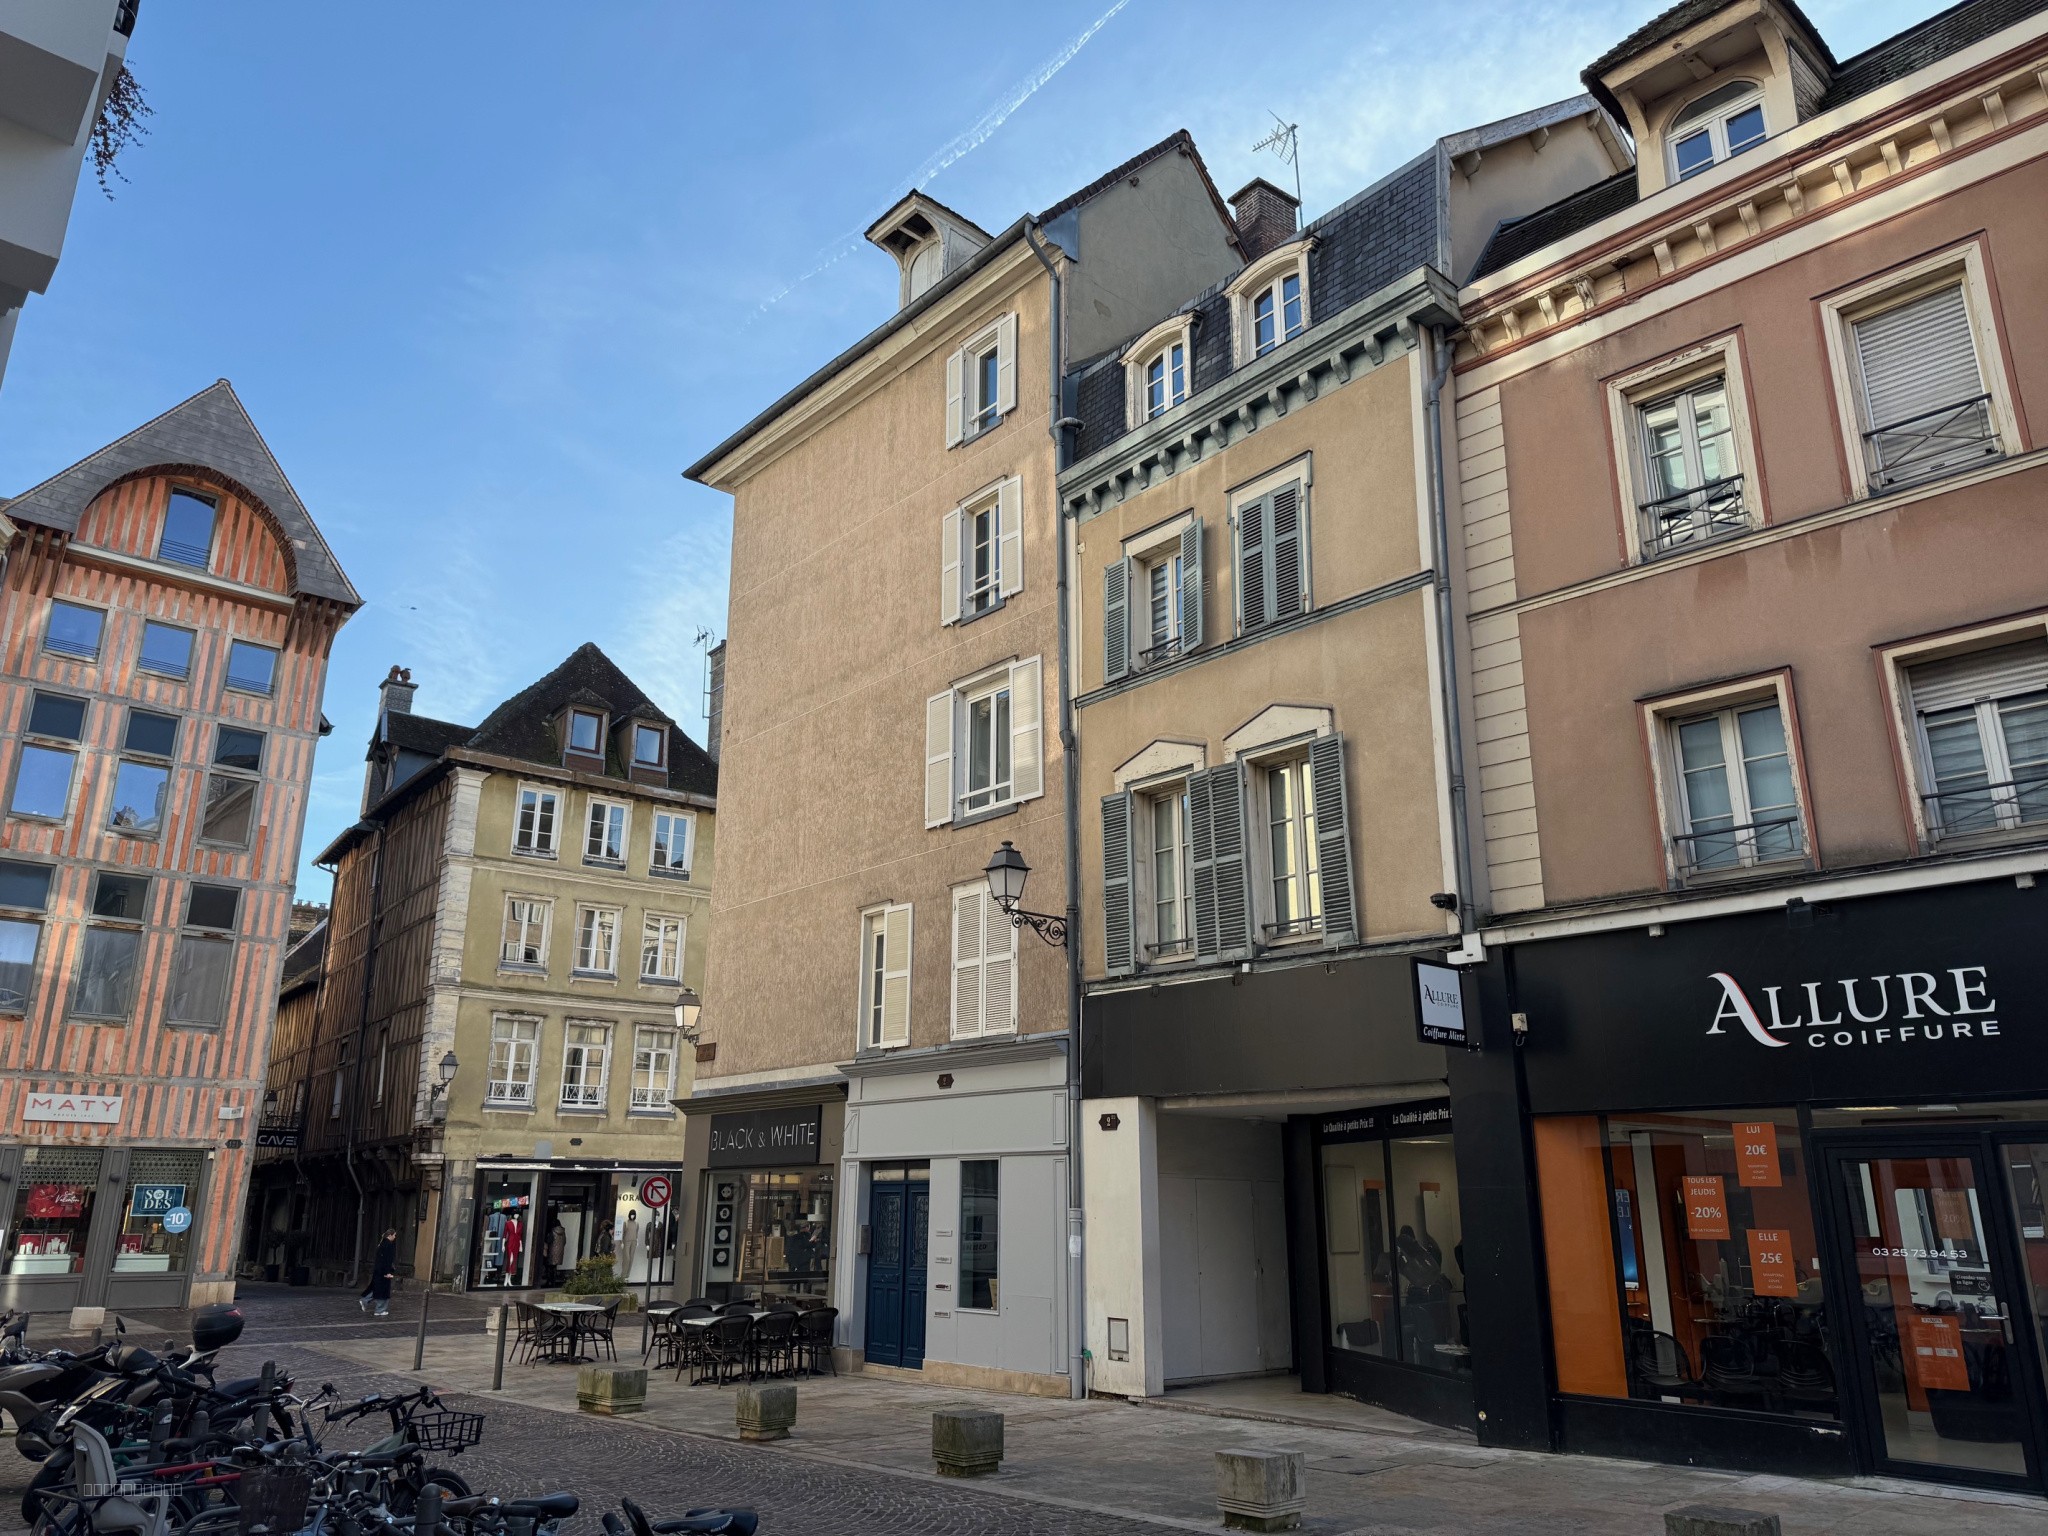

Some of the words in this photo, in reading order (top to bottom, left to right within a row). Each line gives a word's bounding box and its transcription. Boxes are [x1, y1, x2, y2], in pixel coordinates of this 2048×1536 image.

[1423, 1026, 1447, 1040] Coiffure
[1448, 1030, 1466, 1041] Mixte
[1808, 1022, 2002, 1047] COIFFURE
[32, 1098, 116, 1112] MATY
[1392, 1114, 1399, 1125] La
[1399, 1110, 1418, 1124] Qualité
[1422, 1109, 1437, 1124] petits
[1438, 1108, 1449, 1120] Prix
[1323, 1123, 1328, 1133] La
[1360, 1118, 1368, 1129] Prix
[1746, 1125, 1761, 1134] LUI
[258, 1134, 294, 1146] CAVE
[711, 1128, 754, 1151] BLACK
[758, 1131, 766, 1148] &
[771, 1123, 816, 1147] WHITE
[1745, 1144, 1768, 1155] 20€
[1690, 1188, 1717, 1196] JEUDIS
[1690, 1206, 1722, 1218] -20%
[1758, 1232, 1779, 1241] ELLE
[1760, 1252, 1784, 1264] 25€
[1872, 1247, 1889, 1256] 03
[1892, 1248, 1908, 1257] 25
[1911, 1249, 1927, 1258] 73
[1930, 1249, 1947, 1258] 94
[1950, 1250, 1968, 1259] 53
